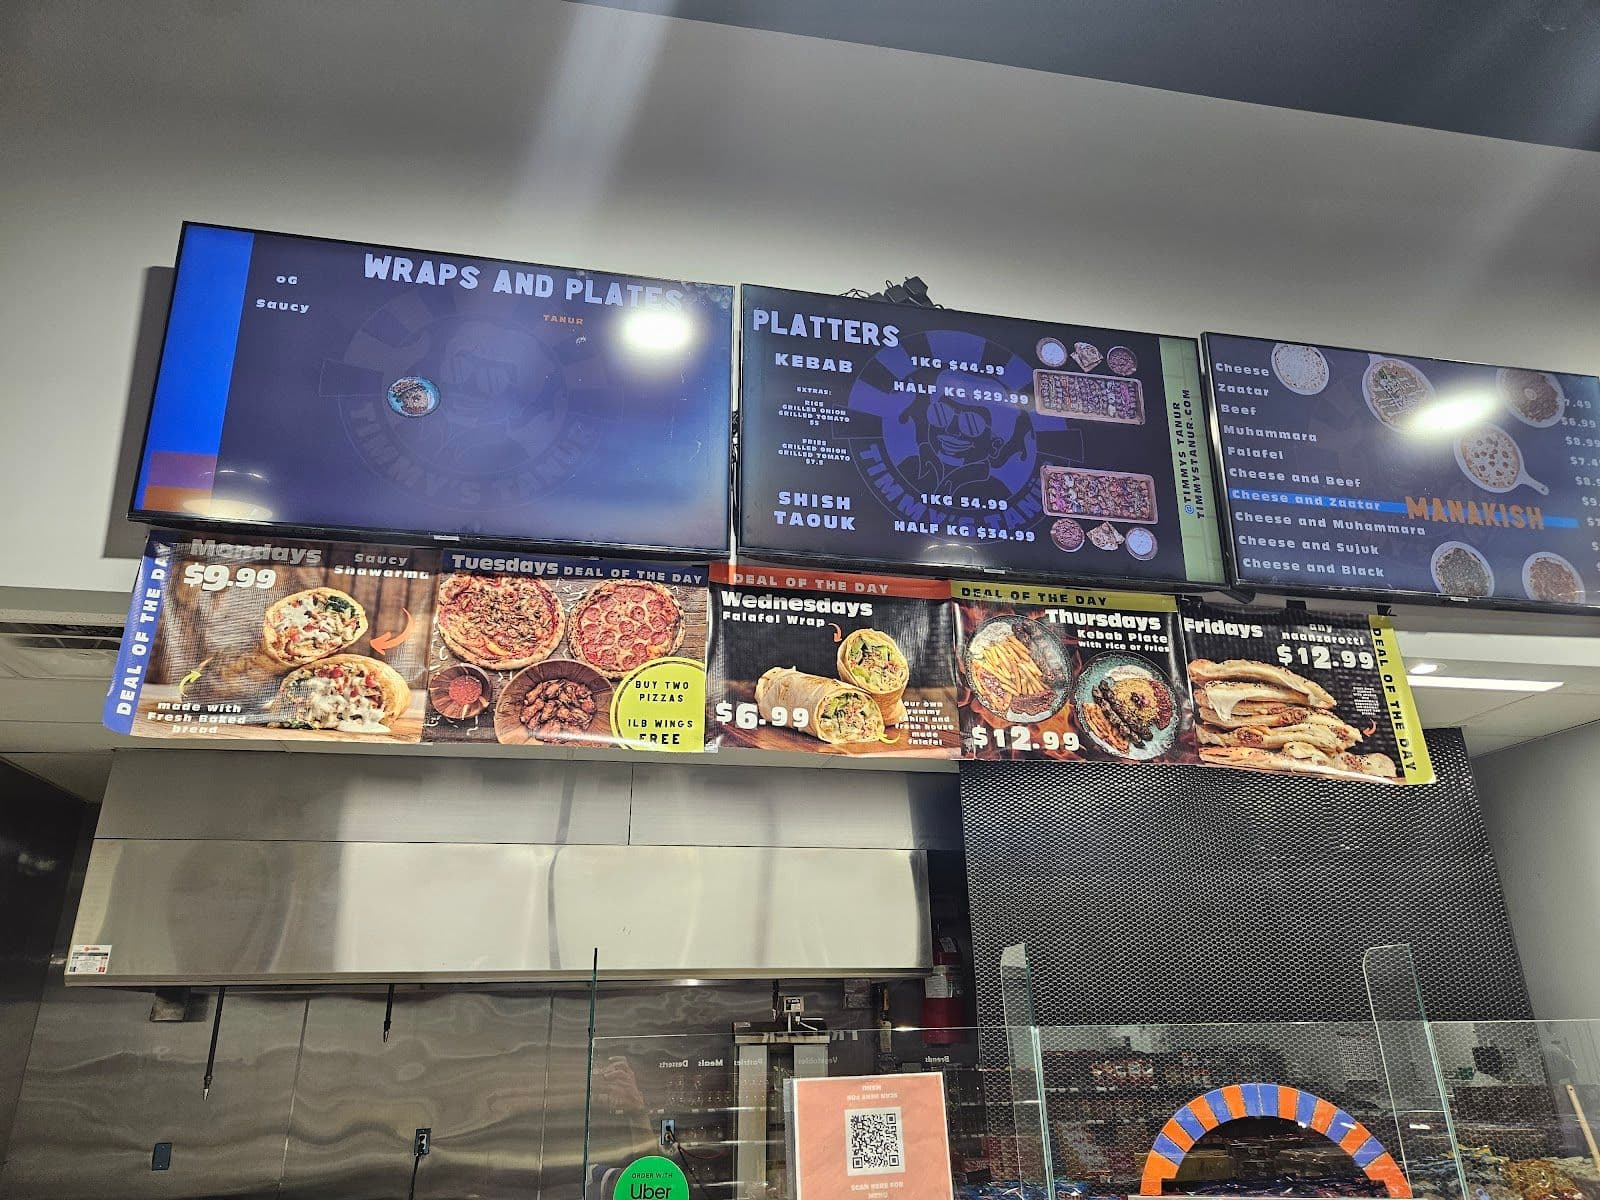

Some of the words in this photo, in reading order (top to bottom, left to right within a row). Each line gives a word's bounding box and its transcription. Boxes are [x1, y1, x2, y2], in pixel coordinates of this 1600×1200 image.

[364, 252, 480, 290] WRAPS
[492, 269, 554, 298] AND
[565, 278, 684, 311] PLATES
[255, 298, 310, 314] Saucy
[543, 313, 584, 325] TANUR
[752, 308, 900, 348] PLATTERS
[774, 352, 854, 375] KEBAB
[910, 356, 942, 370] 1KG
[949, 358, 1006, 376] $44.99
[1215, 362, 1270, 378] Cheese
[796, 386, 832, 396] EXTRAS:
[893, 380, 937, 395] HALF
[943, 385, 968, 399] KG
[972, 385, 1029, 405] $29.99
[1217, 382, 1270, 397] Zaatar
[778, 410, 814, 419] GRILLED
[816, 414, 850, 423] TOMATO
[782, 404, 817, 413] GRILLED
[819, 408, 846, 416] ONION
[1220, 403, 1257, 417] Beef
[1172, 401, 1185, 445] TANUR
[802, 438, 827, 446] FRIES
[1223, 424, 1318, 443] Muhammara
[777, 449, 814, 458] GRILLED
[816, 452, 851, 462] TOMATO
[781, 443, 817, 452] GRILLED
[820, 446, 847, 455] ONION
[1182, 389, 1205, 519] TIMMYSTANUR.COM
[1227, 446, 1284, 460] Falafel
[1229, 467, 1286, 482] Cheese
[1291, 471, 1320, 485] and
[1325, 475, 1362, 489] Beef
[777, 490, 852, 511] SHISH
[920, 493, 953, 506] 1KG
[960, 496, 1009, 511] 54.99
[1232, 489, 1290, 504] Cheese
[1295, 493, 1323, 507] and
[1329, 497, 1382, 511] Zaatar
[774, 510, 856, 532] TAOUK
[1405, 495, 1545, 530] MANAKISH
[894, 520, 939, 534] HALF
[946, 524, 970, 537] KG
[976, 526, 1036, 542] $34.99
[1235, 511, 1293, 526] Cheese
[1298, 515, 1327, 529] and
[1332, 518, 1426, 536] Muhammara
[189, 538, 322, 565] Mondays
[1238, 534, 1296, 549] Cheese
[1301, 539, 1331, 553] and
[1336, 541, 1380, 556] Sujuk
[354, 553, 408, 567] Saucy
[451, 554, 559, 576] Tuesdays
[563, 565, 604, 577] DEAL
[610, 568, 630, 578] OF
[636, 569, 666, 581] THE
[671, 573, 703, 585] DAY
[1242, 557, 1301, 573] Cheese
[1306, 561, 1336, 576] and
[1341, 565, 1385, 579] Black
[183, 561, 277, 592] $9.99
[733, 573, 779, 587] DEAL
[785, 577, 808, 588] OF
[815, 579, 847, 592] THE
[854, 583, 890, 594] DAY
[139, 588, 161, 623] THE
[720, 590, 874, 617] Wednesdays
[961, 587, 1003, 599] DEAL
[1010, 590, 1031, 601] OF
[1037, 592, 1069, 603] THE
[1075, 595, 1108, 606] DAY
[722, 611, 781, 624] Falafel
[787, 614, 826, 628] Wrap
[1045, 608, 1162, 632] Thursdays
[1183, 617, 1264, 639] Fridays
[1309, 622, 1333, 633] any
[131, 632, 150, 656] OF
[1077, 629, 1123, 641] Kebab
[1128, 632, 1168, 644] Plate
[1078, 640, 1103, 650] with
[1105, 642, 1127, 651] rice
[1144, 643, 1170, 653] fries
[1281, 631, 1365, 646] naanzarotti
[1276, 643, 1375, 670] $12.99
[115, 665, 142, 716] DEAL
[635, 680, 658, 689] BUY
[664, 681, 690, 690] TWO
[157, 702, 201, 711] made
[207, 703, 242, 713] with
[639, 693, 685, 703] PIZZAS
[1371, 627, 1389, 667] DEAL
[1383, 674, 1396, 693] OF
[1390, 701, 1405, 730] THE
[1399, 738, 1417, 771] DAY
[147, 711, 193, 722] Fresh
[654, 719, 694, 729] WINGS
[715, 700, 810, 730] $6.99
[639, 733, 681, 745] FREE
[971, 725, 1081, 751] $12.99
[630, 1183, 672, 1200] Uber
